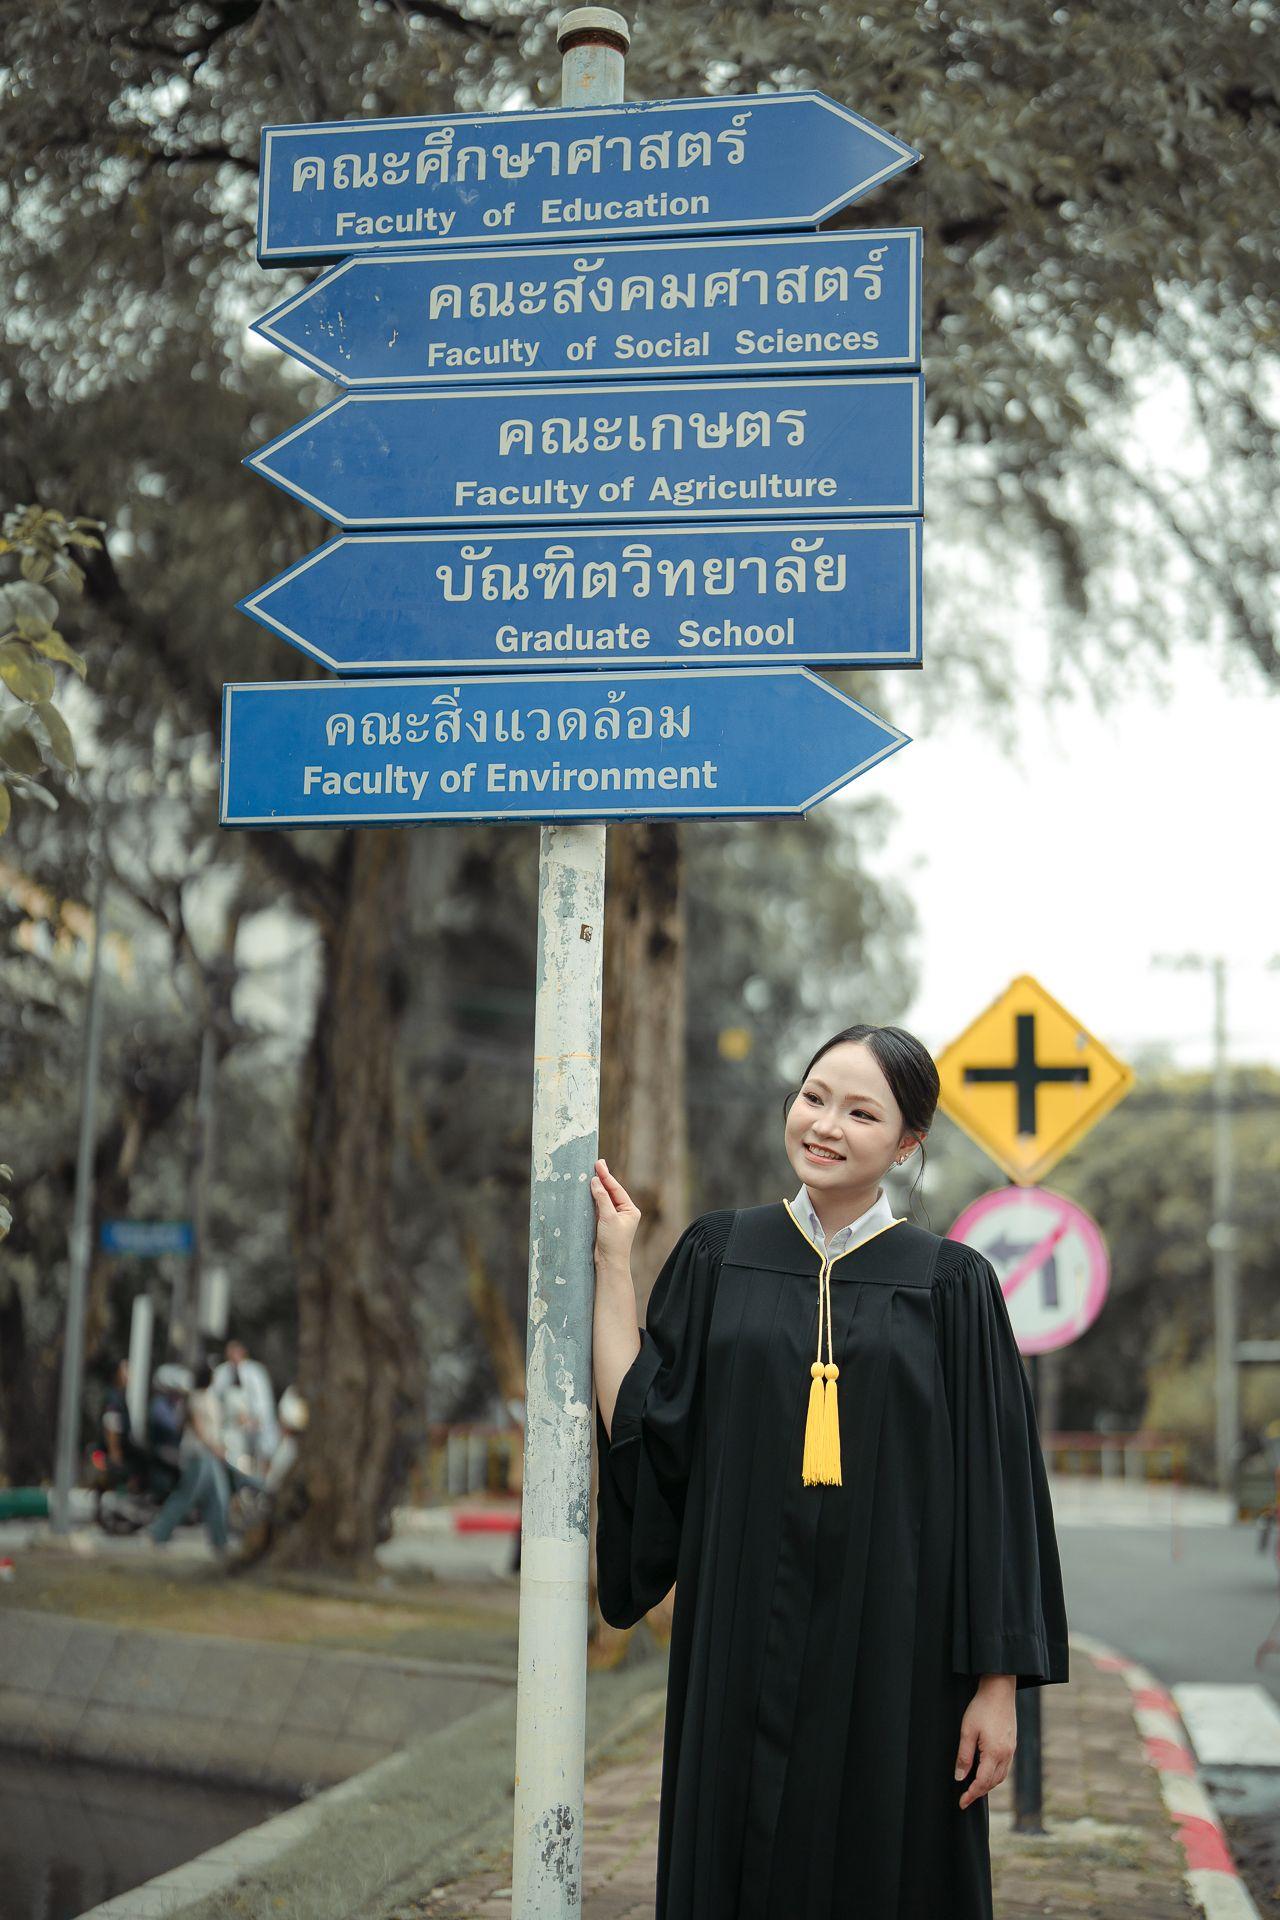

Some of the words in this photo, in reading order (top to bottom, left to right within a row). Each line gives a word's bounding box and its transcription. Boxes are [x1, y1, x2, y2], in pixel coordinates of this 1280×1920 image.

[291, 110, 752, 192] คณะศึกษาศาสตร์
[337, 208, 456, 236] Faculty
[483, 202, 515, 226] of
[542, 193, 710, 223] Education
[427, 243, 888, 319] คณะสังคมศาสตร์
[428, 339, 540, 367] Faculty
[567, 336, 596, 360] of
[614, 332, 709, 359] Social
[735, 329, 878, 354] Sciences
[499, 410, 807, 455] คณะเกษตร
[456, 480, 589, 509] Faculty
[599, 476, 634, 501] of
[649, 473, 838, 508] Agriculture
[435, 536, 847, 602] บัณฑิตวิทยาลัย
[496, 623, 650, 652] Graduate
[678, 618, 794, 647] School
[325, 686, 691, 746] คณะสิ่งแวดล้อม
[304, 764, 429, 800] Faculty
[440, 763, 476, 792] of
[488, 761, 717, 791] Environment
